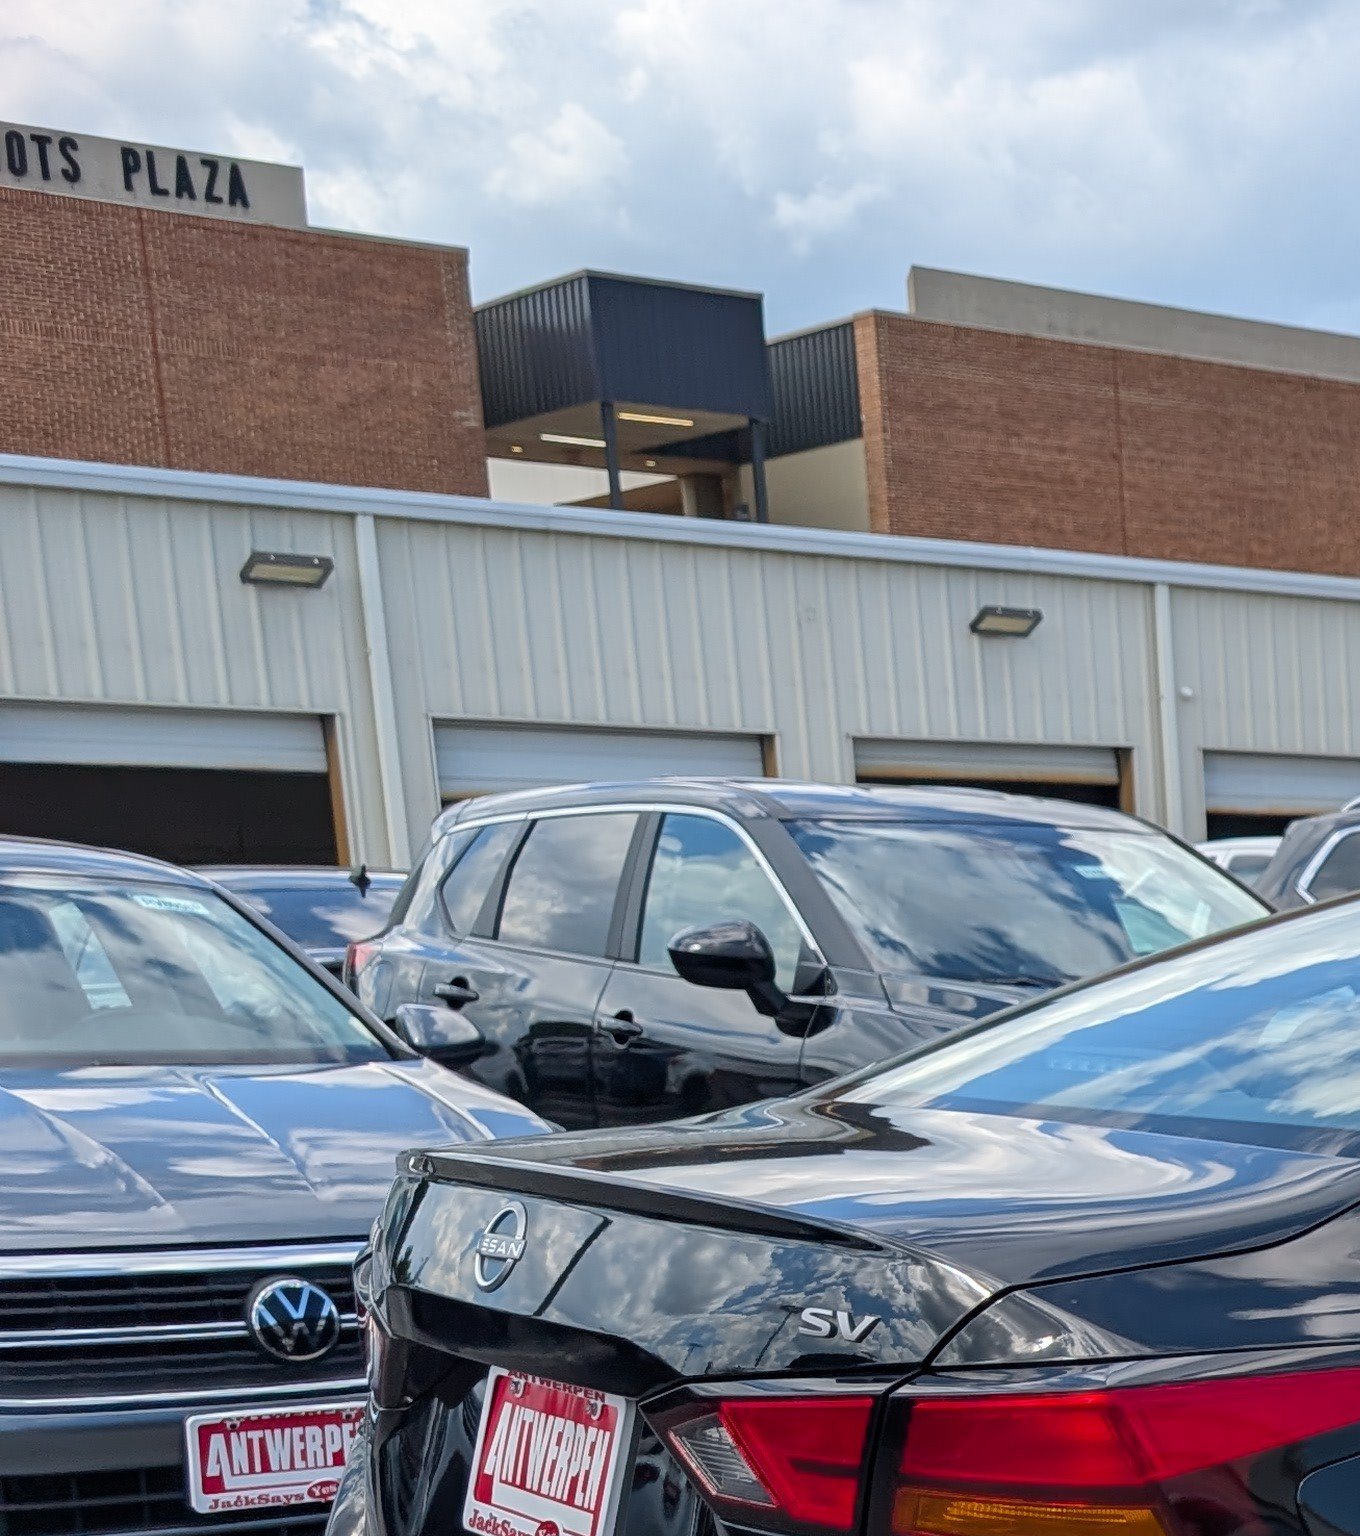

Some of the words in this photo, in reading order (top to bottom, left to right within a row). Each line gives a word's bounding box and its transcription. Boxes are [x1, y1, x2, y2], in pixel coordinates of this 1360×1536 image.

[120, 146, 250, 209] PLAZA
[799, 1307, 880, 1342] SV
[506, 1369, 606, 1402] ANTWERPEN
[206, 1421, 360, 1478] ANTWERPE
[484, 1401, 611, 1511] ANTWERPEN
